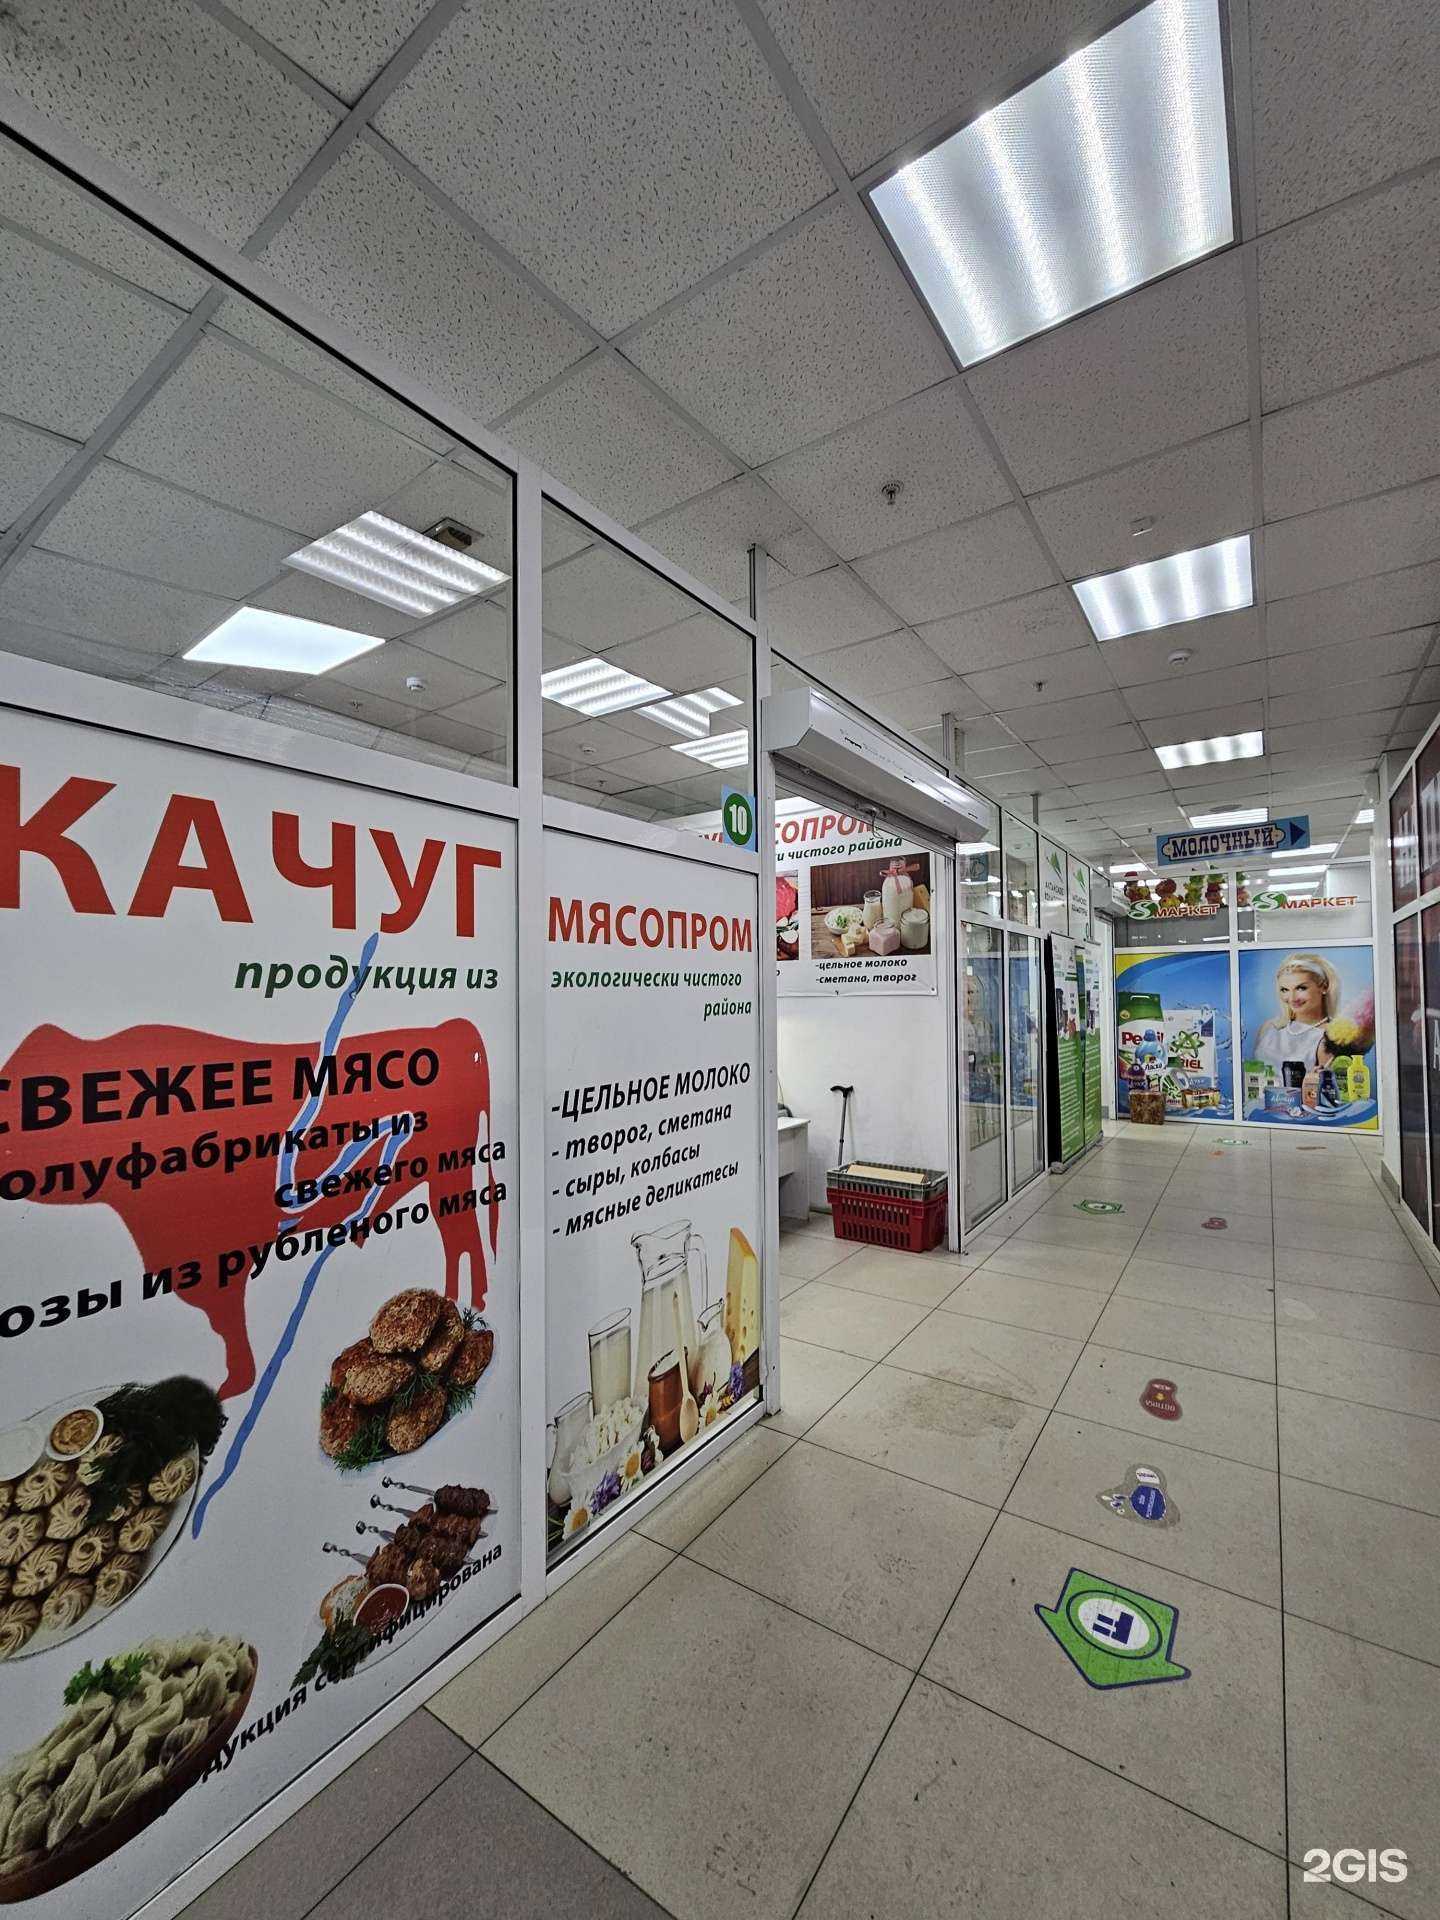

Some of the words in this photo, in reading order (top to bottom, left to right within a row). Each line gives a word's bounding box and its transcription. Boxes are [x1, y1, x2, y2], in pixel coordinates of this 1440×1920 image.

[729, 803, 748, 836] 10
[0, 765, 502, 938] КАЧУГ
[787, 847, 845, 862] чистого
[847, 836, 903, 855] района
[1171, 827, 1276, 858] МОЛОЧНЫЙ
[548, 896, 753, 952] МЯСОПРОМ
[234, 953, 456, 998] продукция
[466, 966, 499, 990] из
[551, 970, 680, 989] экологически
[684, 972, 743, 987] чистого
[865, 958, 908, 968] молоко
[873, 973, 917, 983] творог
[703, 998, 752, 1022] района
[1121, 1031, 1164, 1045] Peil
[293, 1047, 440, 1100] МЯСО
[674, 1062, 751, 1097] МОЛОКО
[391, 1111, 429, 1136] из
[565, 1123, 653, 1159] творог,
[658, 1104, 732, 1136] сметана
[273, 1153, 428, 1208] свежего
[437, 1139, 507, 1174] мяса
[565, 1167, 625, 1197] сыры,
[630, 1144, 701, 1177] колбасы
[565, 1195, 641, 1237] мясные
[645, 1162, 739, 1206] деликатесы
[142, 1260, 202, 1300] из
[218, 1202, 429, 1288] рубленого
[439, 1182, 508, 1215] мяса
